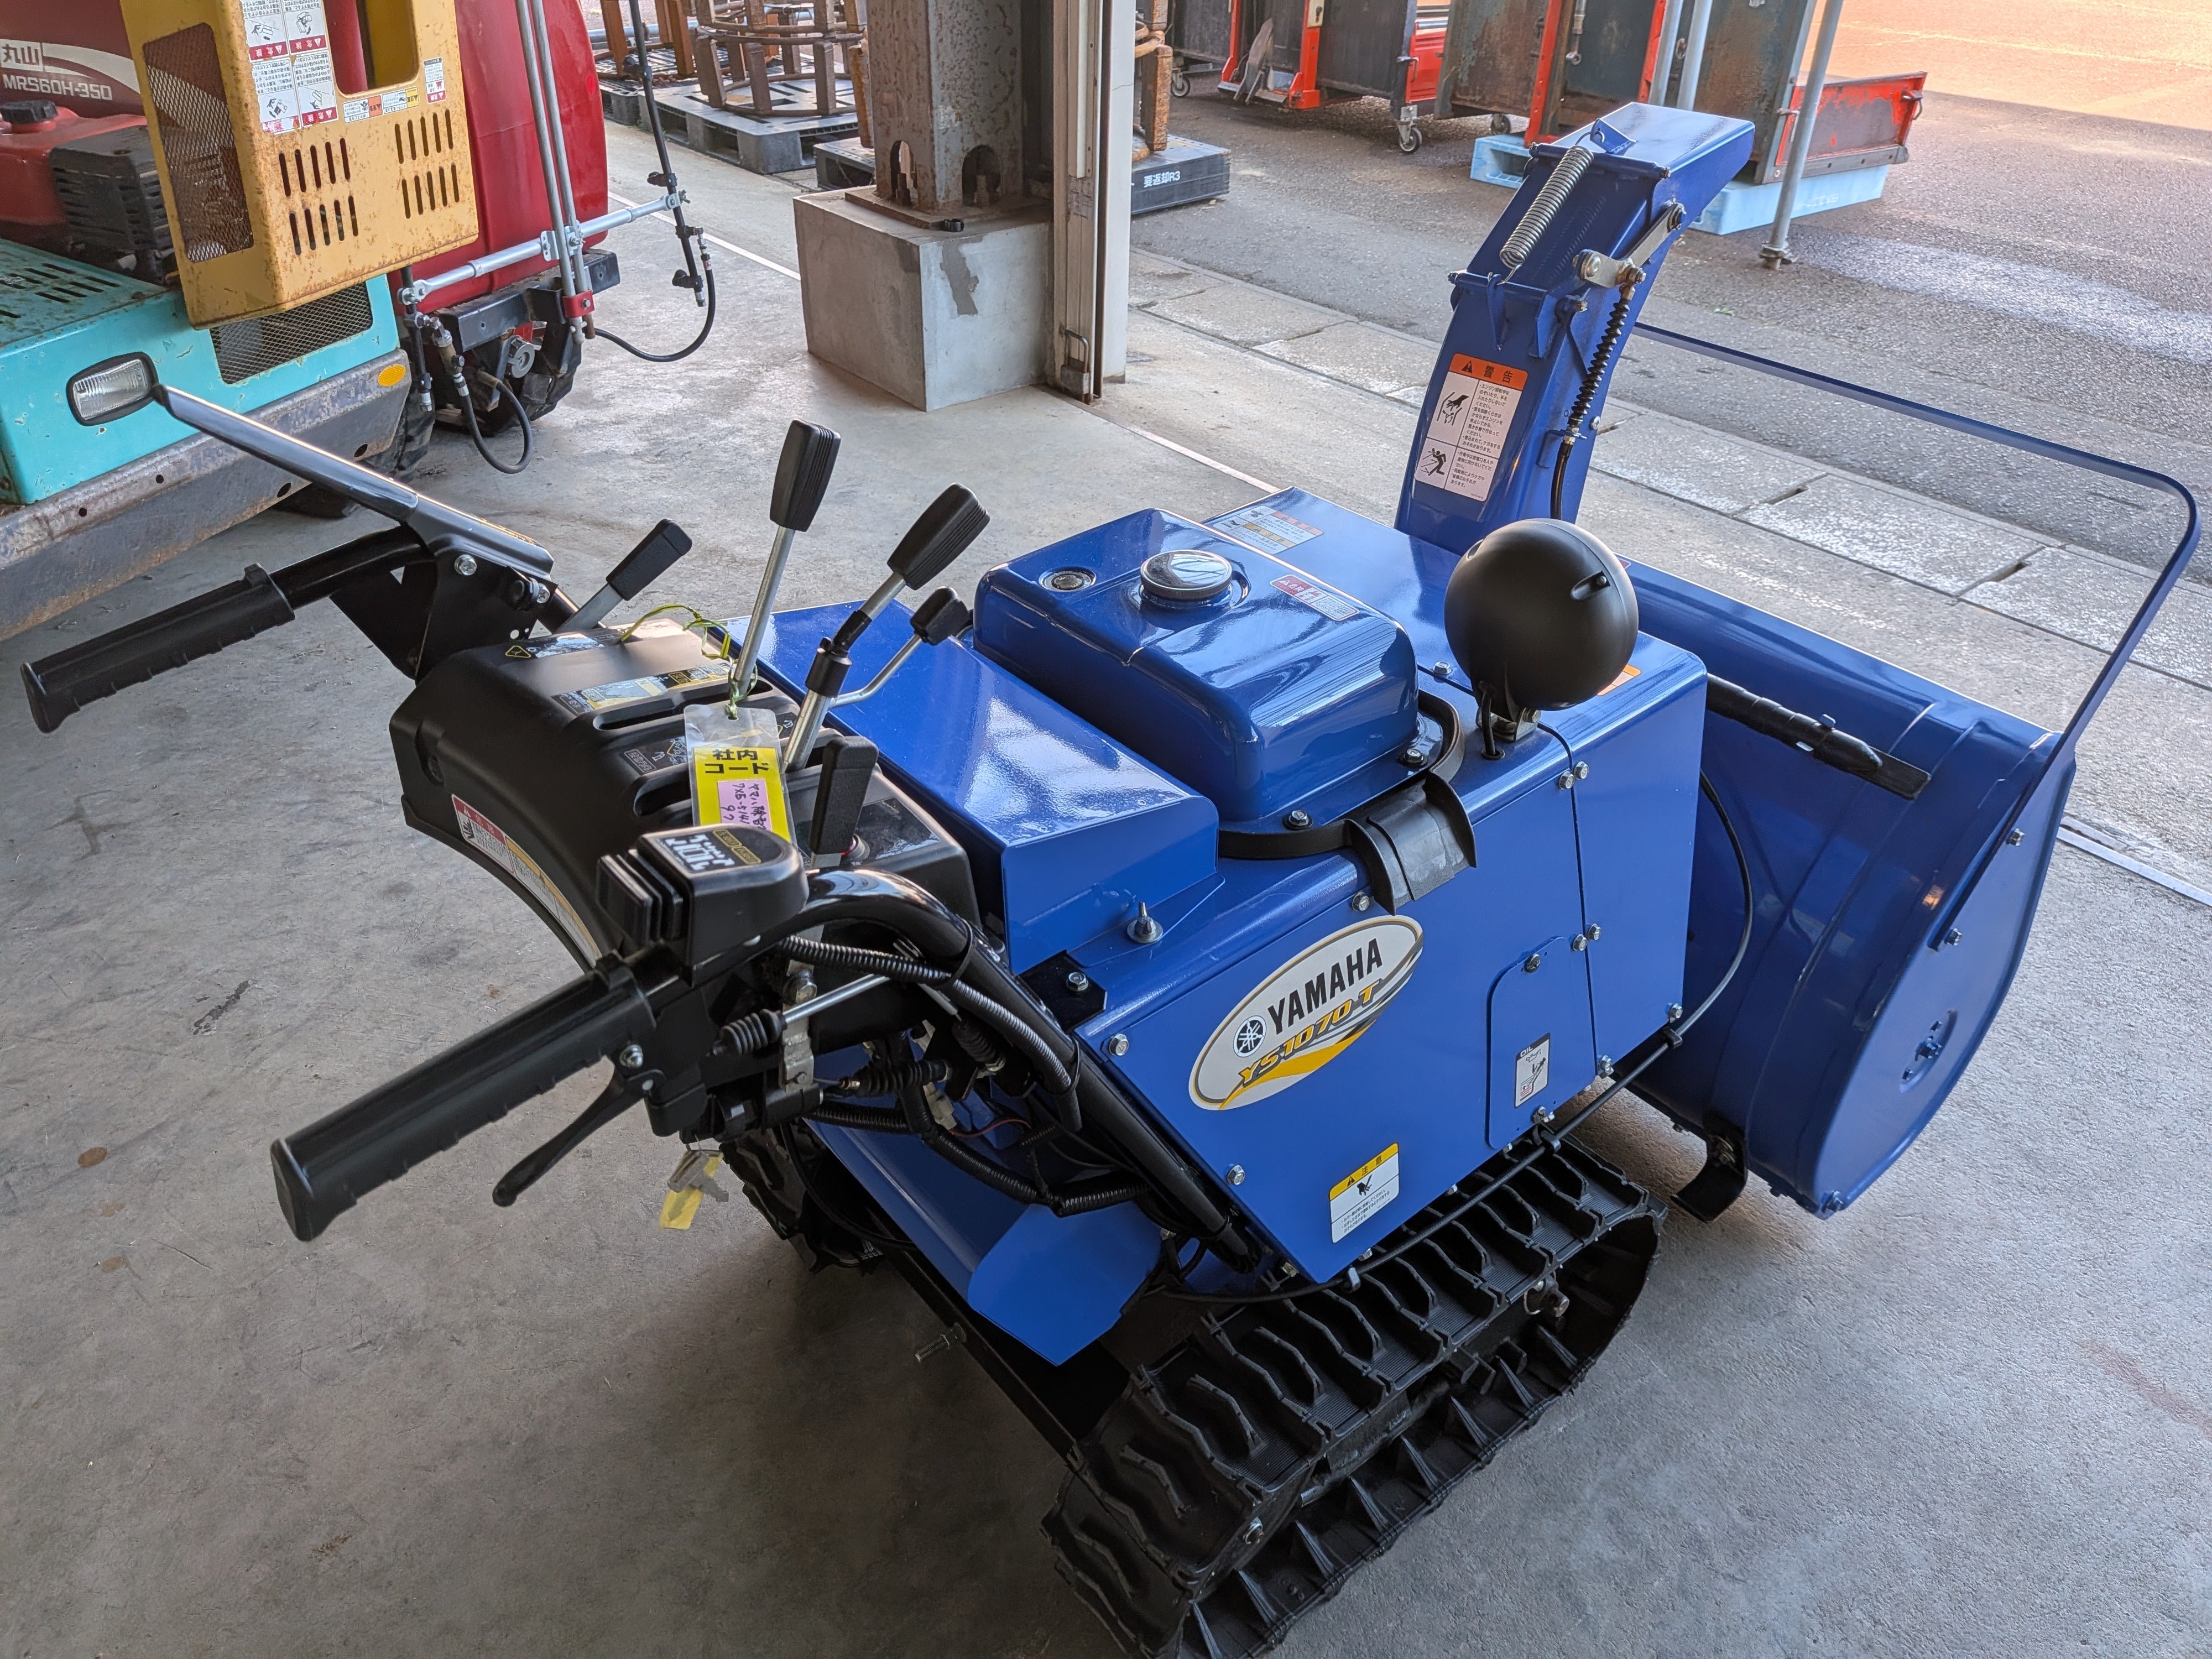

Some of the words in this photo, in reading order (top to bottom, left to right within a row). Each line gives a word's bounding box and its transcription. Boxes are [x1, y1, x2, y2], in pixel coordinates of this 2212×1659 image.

[296, 39, 312, 49] 危険
[2, 44, 38, 65] 丸山
[256, 46, 273, 57] 危険
[2, 74, 112, 100] MRS60H-350
[309, 112, 324, 122] 危険
[1144, 171, 1180, 187] 要返却R3
[1484, 365, 1513, 383] 警告
[712, 749, 758, 760] 社内
[705, 763, 769, 774] コード
[1267, 938, 1383, 1035] YAMAHA
[1520, 1046, 1533, 1057] OIL
[1362, 1155, 1382, 1176] 注意
